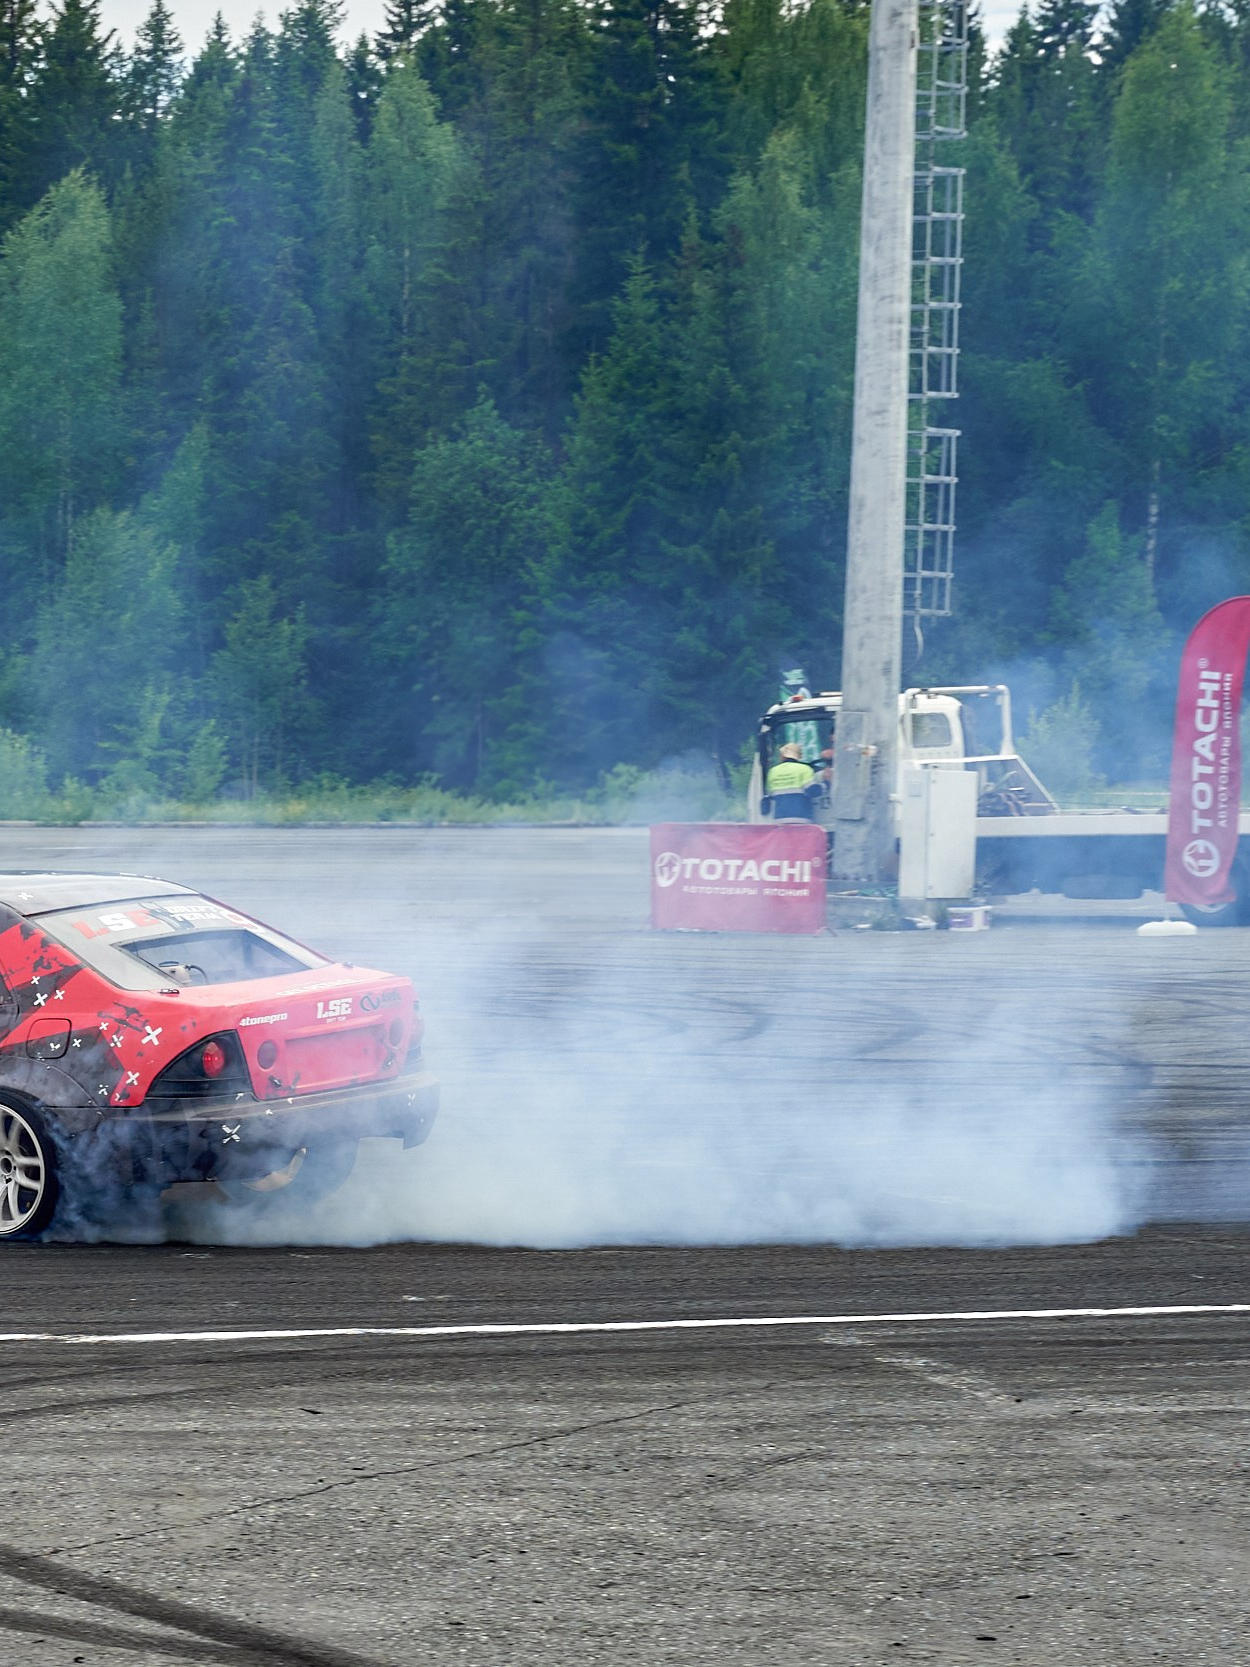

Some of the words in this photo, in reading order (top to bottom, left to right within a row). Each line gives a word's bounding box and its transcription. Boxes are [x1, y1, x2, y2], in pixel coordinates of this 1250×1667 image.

[1223, 673, 1233, 729] ЯПОНИЯ
[1191, 671, 1221, 834] TOTACHI
[1218, 736, 1231, 828] АВТОТОВАРЫ
[682, 858, 812, 882] TOTACHI
[72, 909, 161, 940] LSE
[239, 1012, 288, 1027] 4tonepro
[316, 998, 353, 1019] LSE
